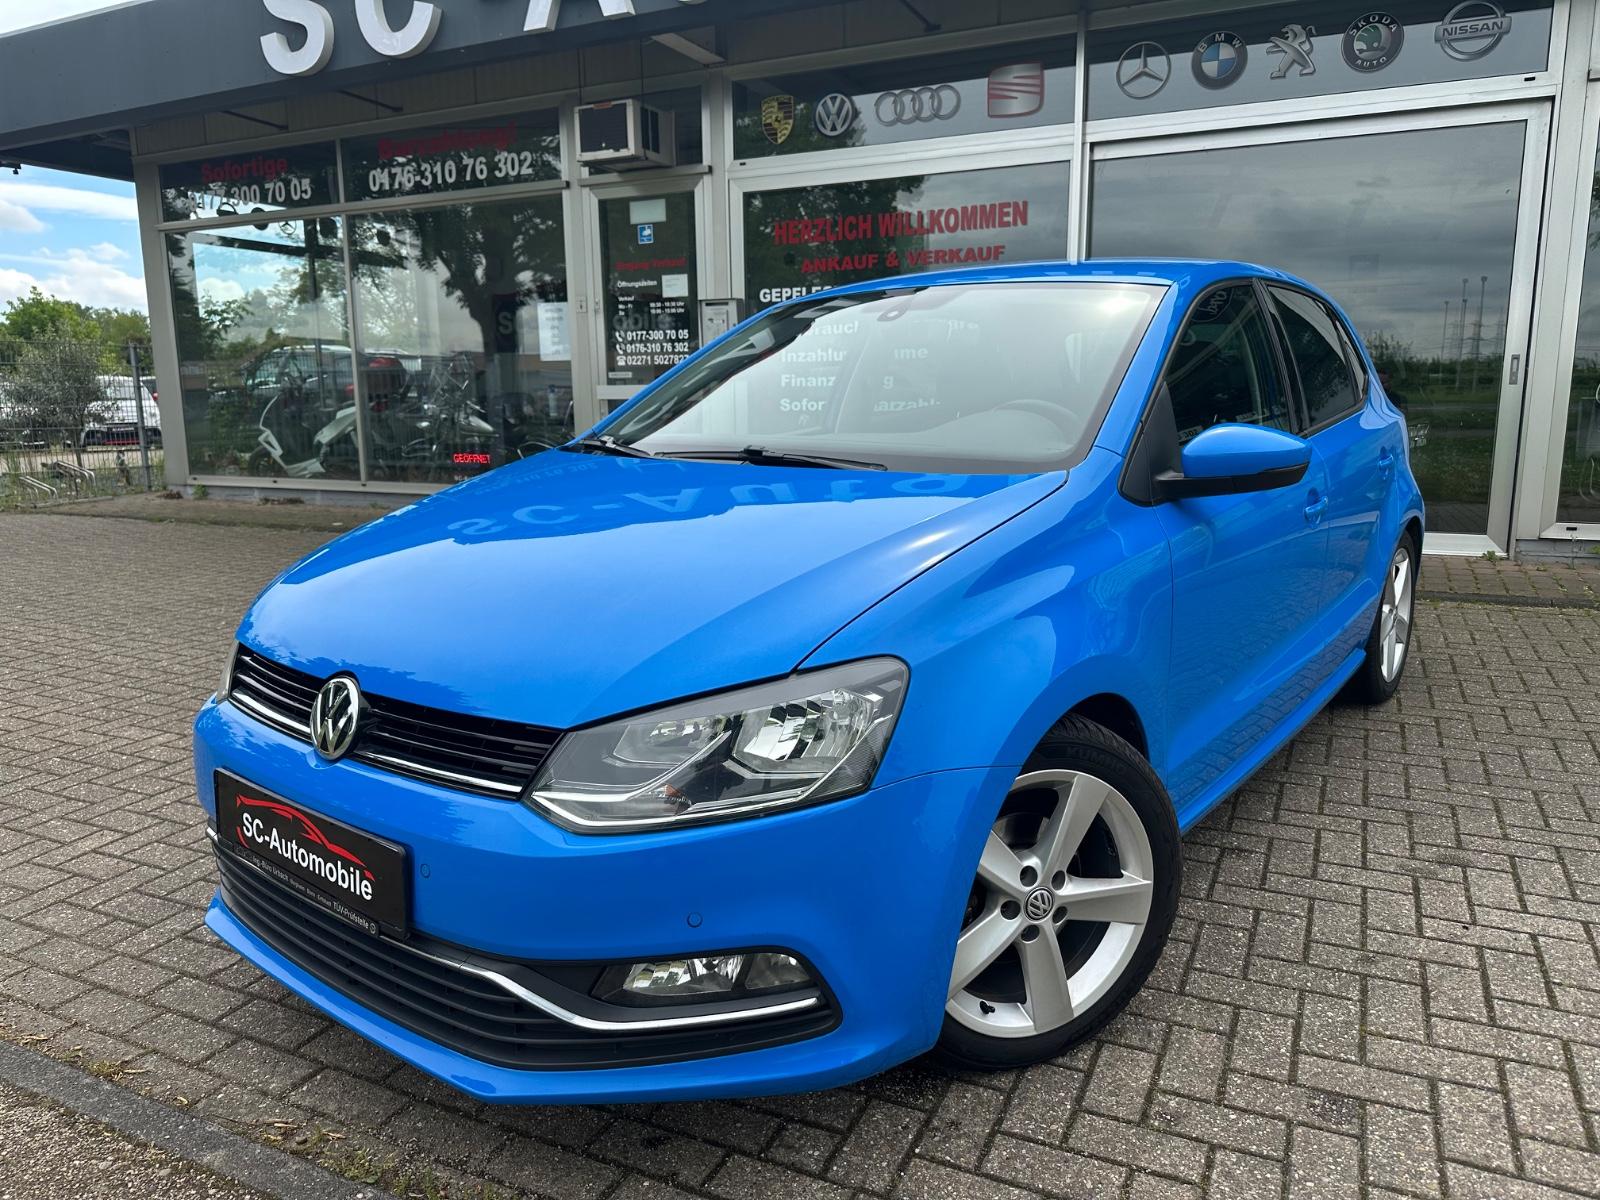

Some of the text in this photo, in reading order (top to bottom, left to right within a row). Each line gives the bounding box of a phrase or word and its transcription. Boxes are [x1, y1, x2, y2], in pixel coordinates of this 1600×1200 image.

[1441, 21, 1504, 37] NISSAN
[1197, 32, 1242, 53] BMW
[1354, 56, 1388, 68] AUTO
[202, 156, 288, 183] Sofortige
[369, 150, 533, 192] 0176-310 76 302
[264, 182, 285, 204] 70
[290, 178, 312, 200] 05
[773, 200, 1029, 245] HERZLICH WILLKOMMEN
[802, 245, 1005, 273] ANKAUF & VERKAUF
[617, 279, 658, 288] Öffnungszeiten
[626, 329, 689, 340] 0177-300 70 05
[626, 342, 689, 353] 0176-310 76 302
[626, 355, 652, 365] 02271
[780, 398, 826, 412] Sofor
[242, 813, 373, 901] SC-Automobile
[333, 901, 369, 929] TÜV-Prüfstelle
